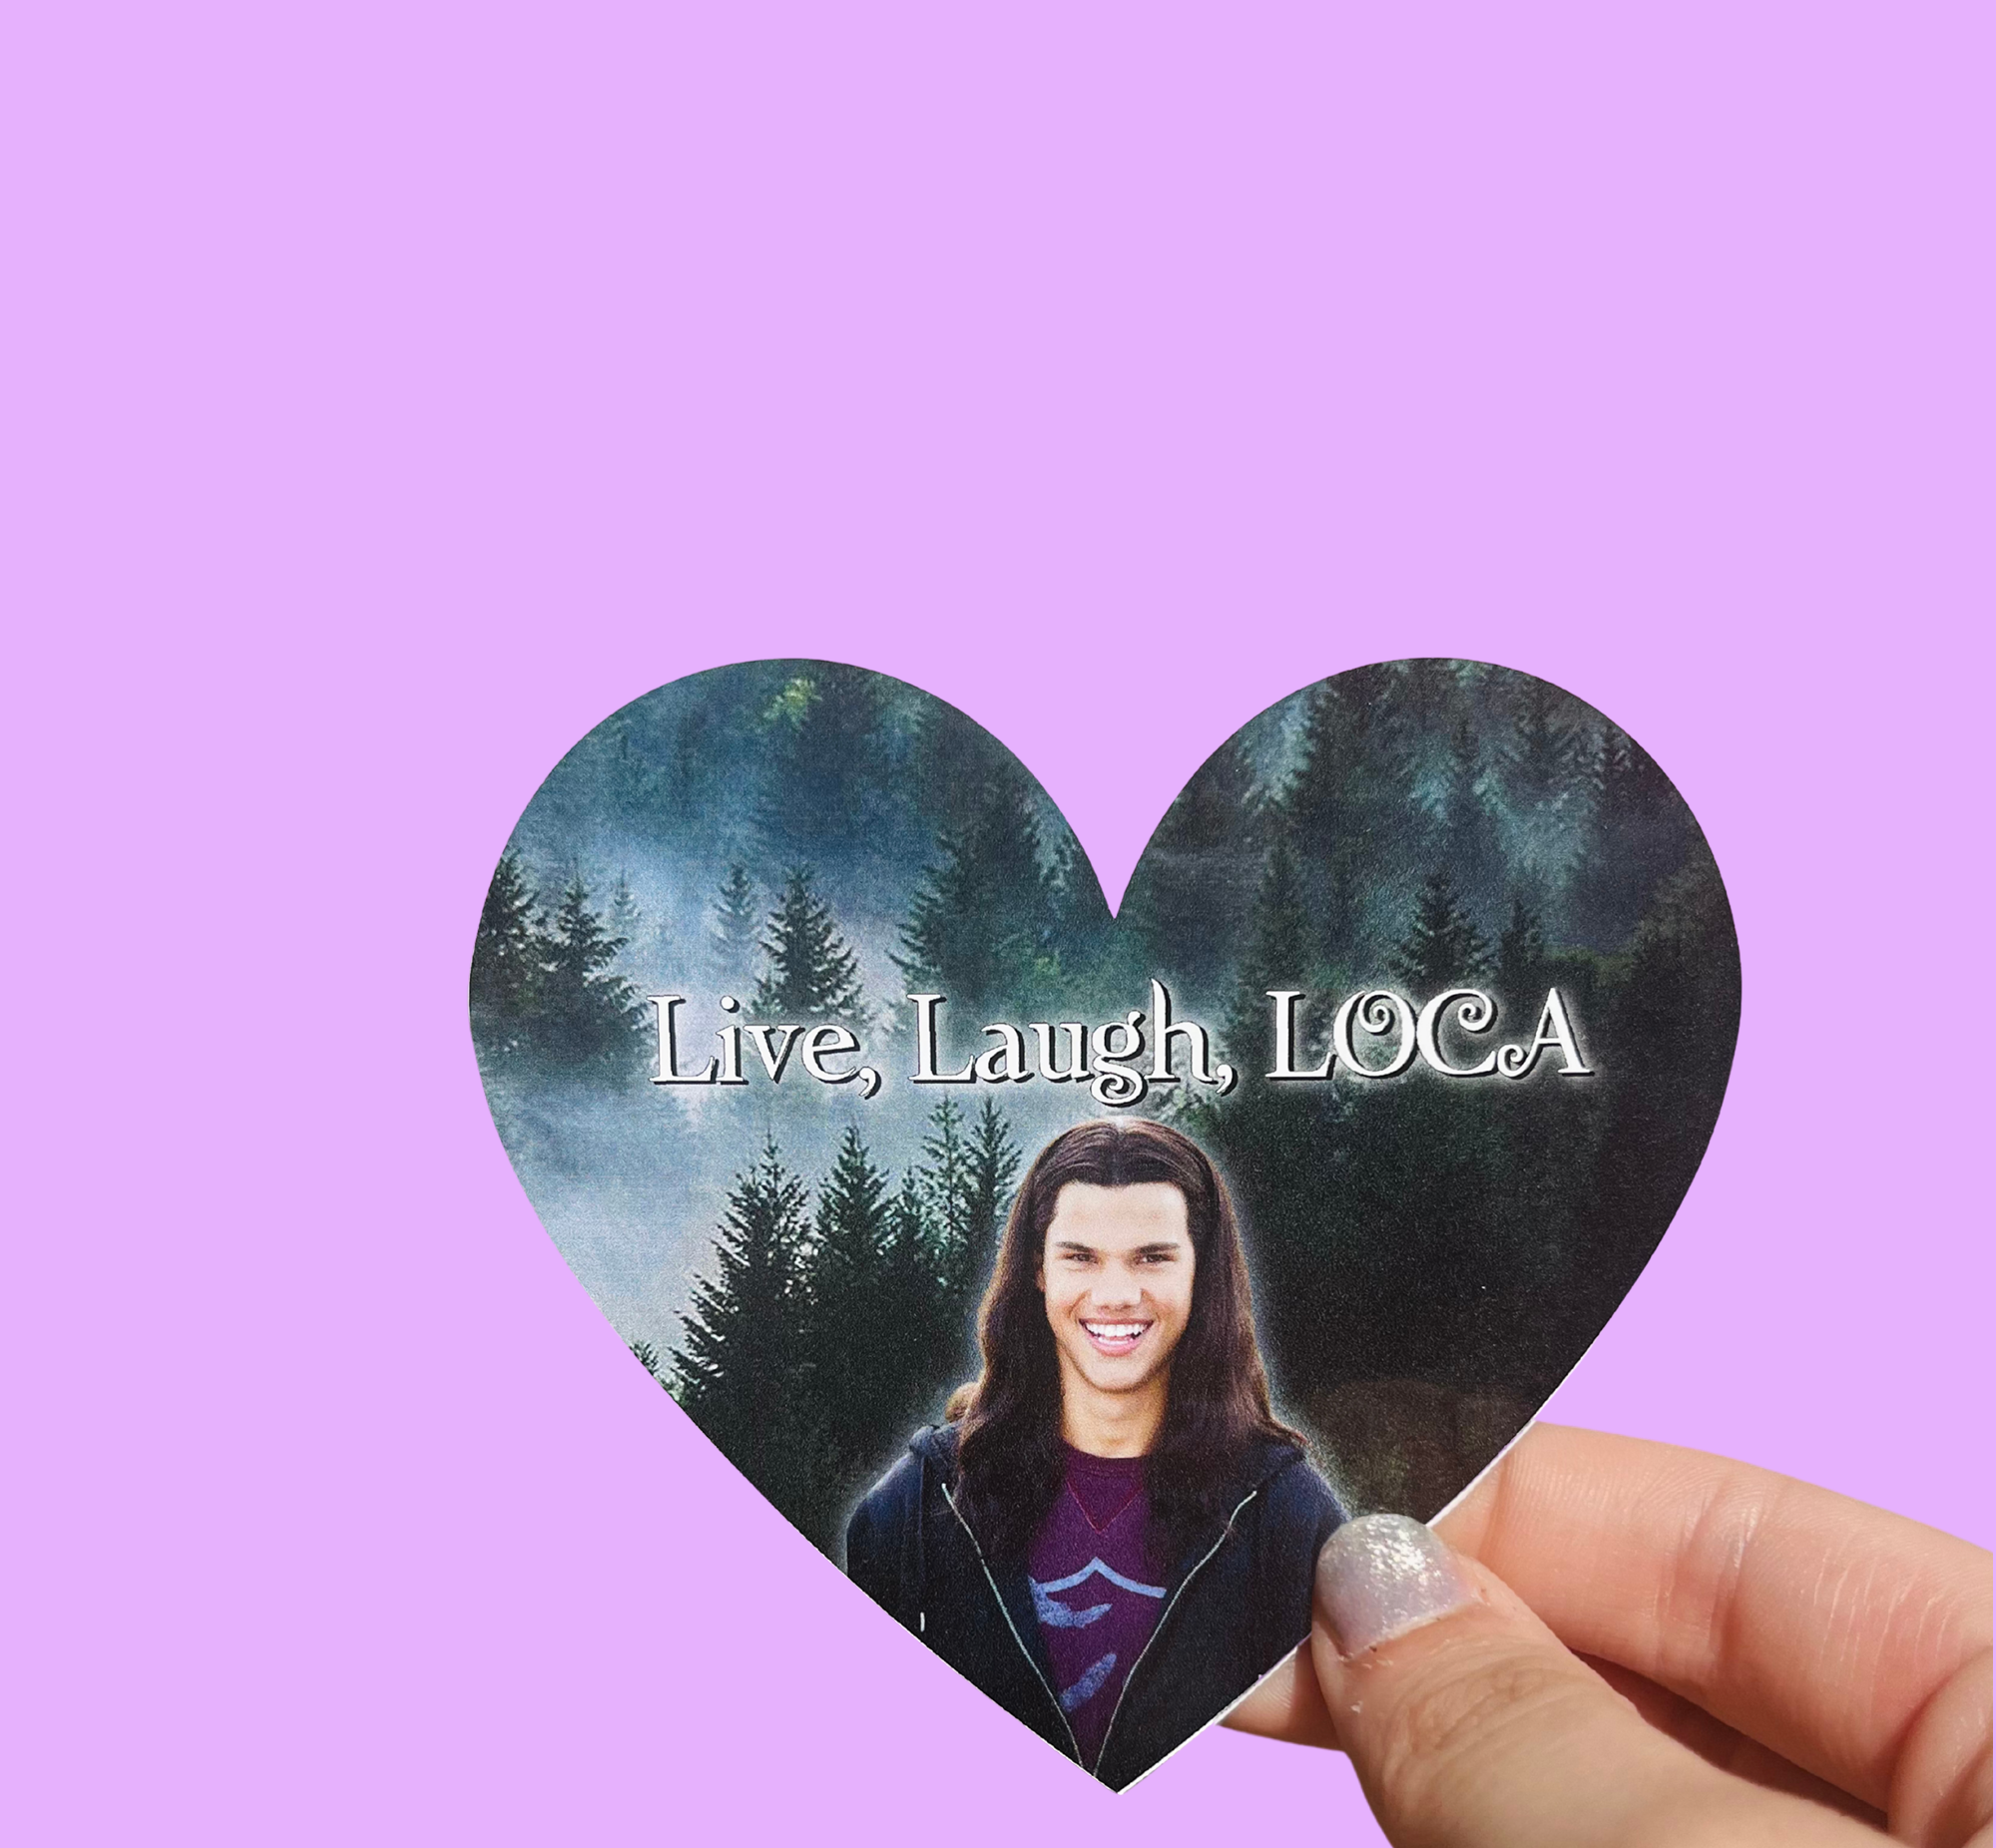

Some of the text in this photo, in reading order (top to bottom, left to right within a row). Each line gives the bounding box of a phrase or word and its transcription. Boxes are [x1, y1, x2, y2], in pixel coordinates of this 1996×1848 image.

[648, 978, 1595, 1108] Live, Laugh, LOCA
